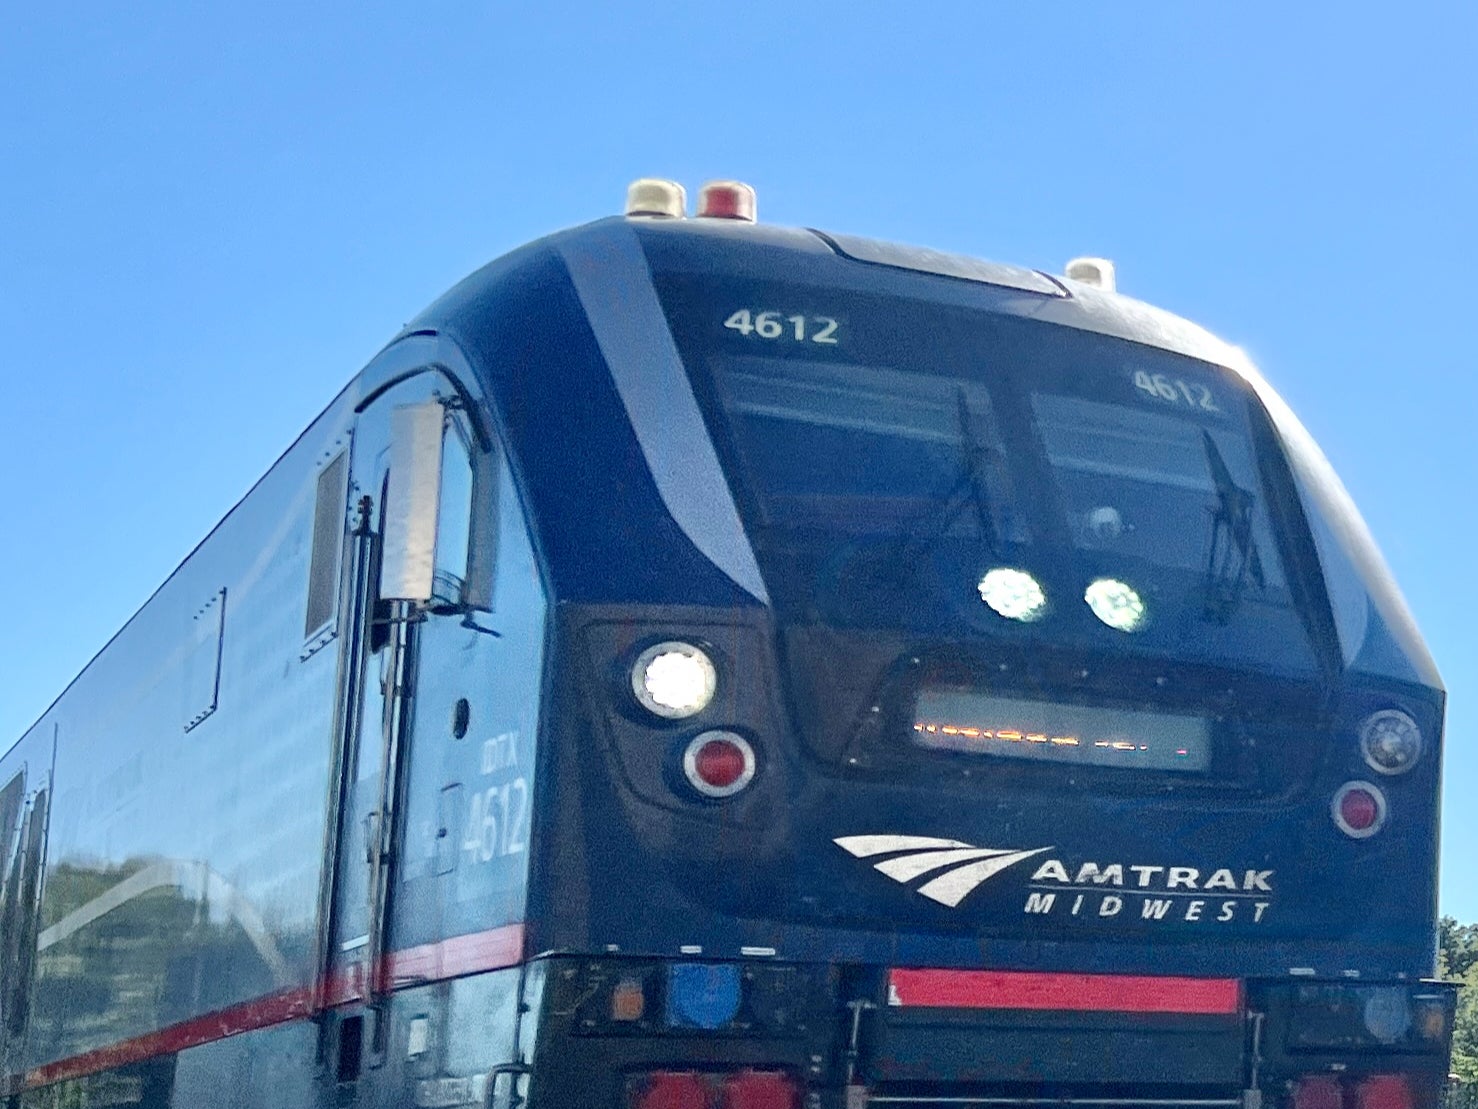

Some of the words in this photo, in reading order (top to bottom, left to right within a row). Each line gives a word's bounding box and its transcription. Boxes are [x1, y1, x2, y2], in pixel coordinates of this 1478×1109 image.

[723, 307, 839, 346] 4612
[1133, 370, 1219, 413] 4612
[463, 778, 527, 864] 4612
[1031, 859, 1274, 892] AMTRAK
[1024, 893, 1270, 923] MIDWEST
